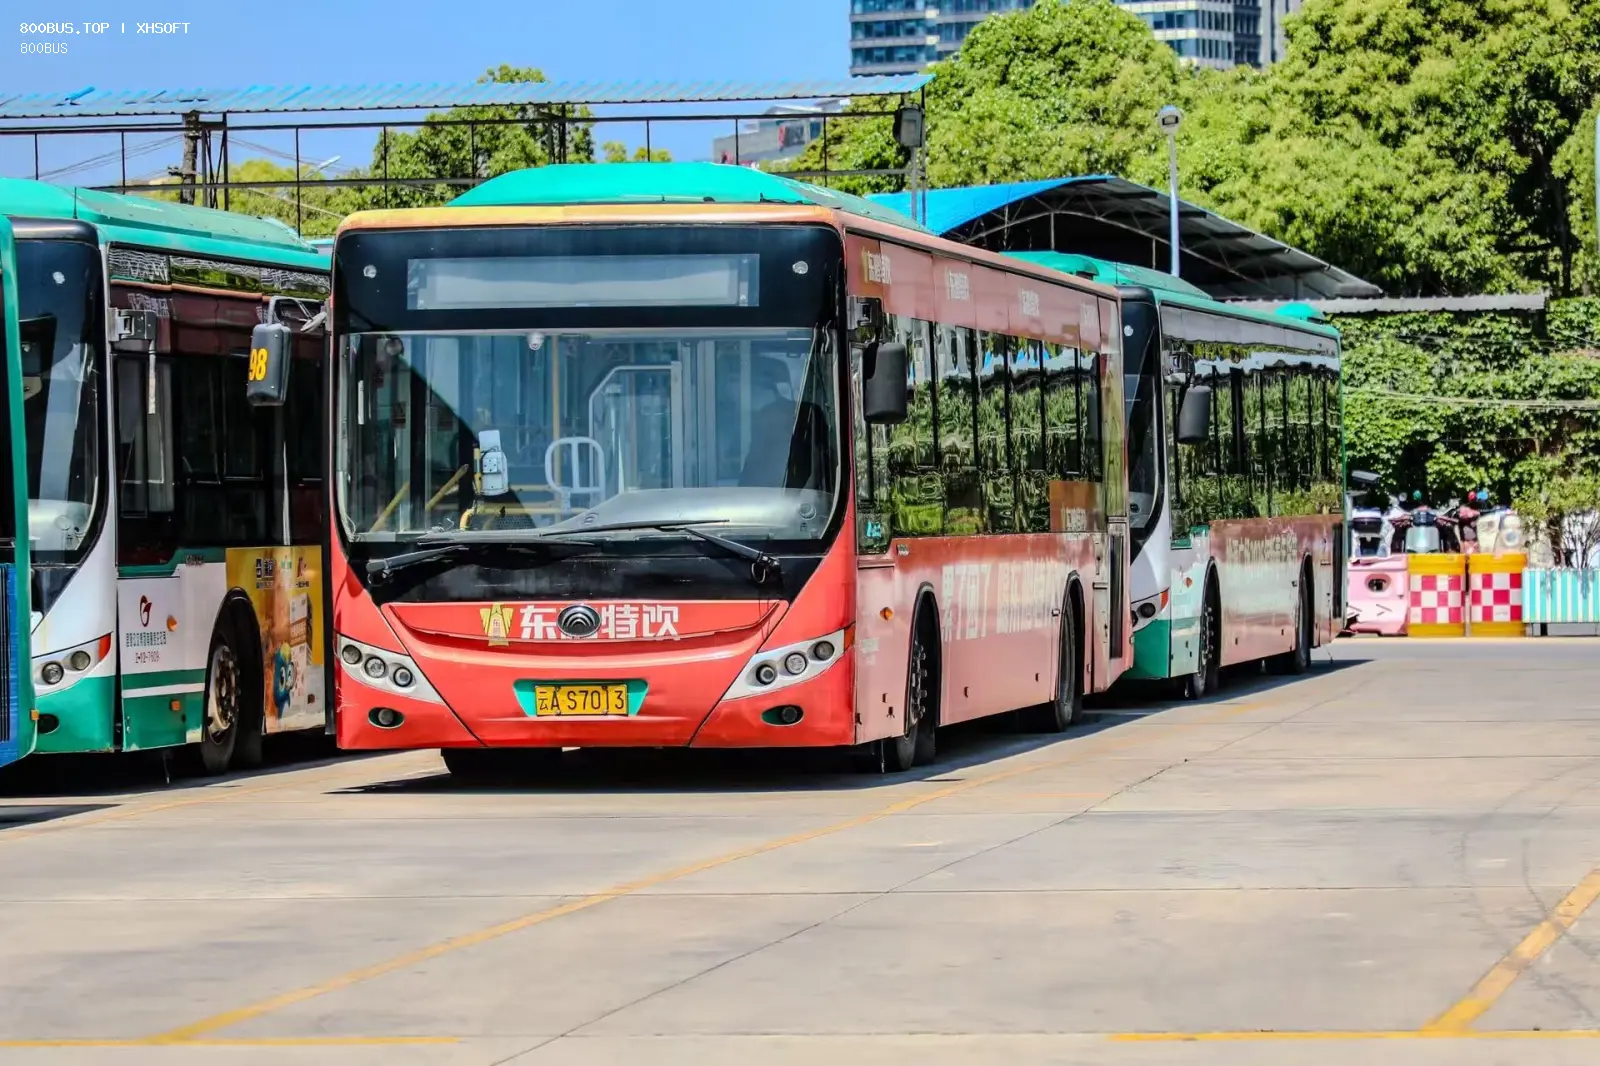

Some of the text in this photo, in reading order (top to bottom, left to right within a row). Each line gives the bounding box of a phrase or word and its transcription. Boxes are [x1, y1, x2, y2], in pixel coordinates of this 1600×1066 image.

[248, 348, 268, 381] 98
[519, 605, 680, 640] 东特饮
